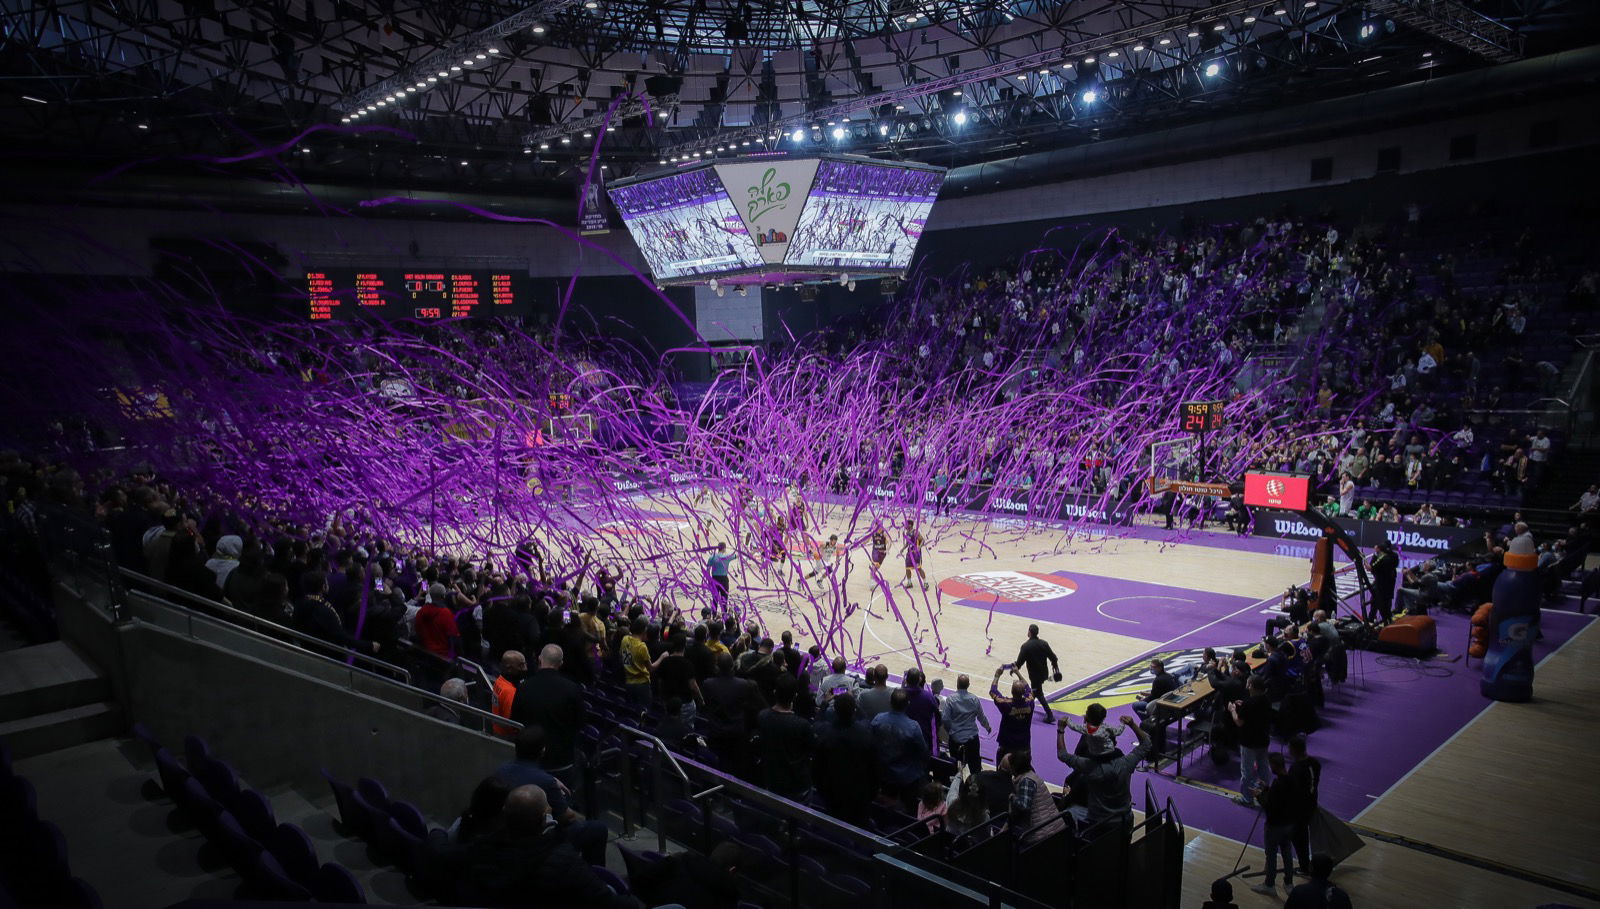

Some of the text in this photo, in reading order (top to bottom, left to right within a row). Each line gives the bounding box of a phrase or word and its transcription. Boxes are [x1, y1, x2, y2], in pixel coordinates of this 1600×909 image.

[421, 308, 439, 318] 9:59
[1187, 404, 1208, 415] 9:59
[1185, 415, 1205, 430] 24
[1211, 413, 1222, 429] 24
[1178, 484, 1193, 492] חולון
[991, 496, 1029, 512] Wilson
[1065, 503, 1107, 521] Wilson
[1274, 519, 1324, 538] Wilson
[1386, 529, 1450, 551] Wilson
[1508, 622, 1529, 641] G
